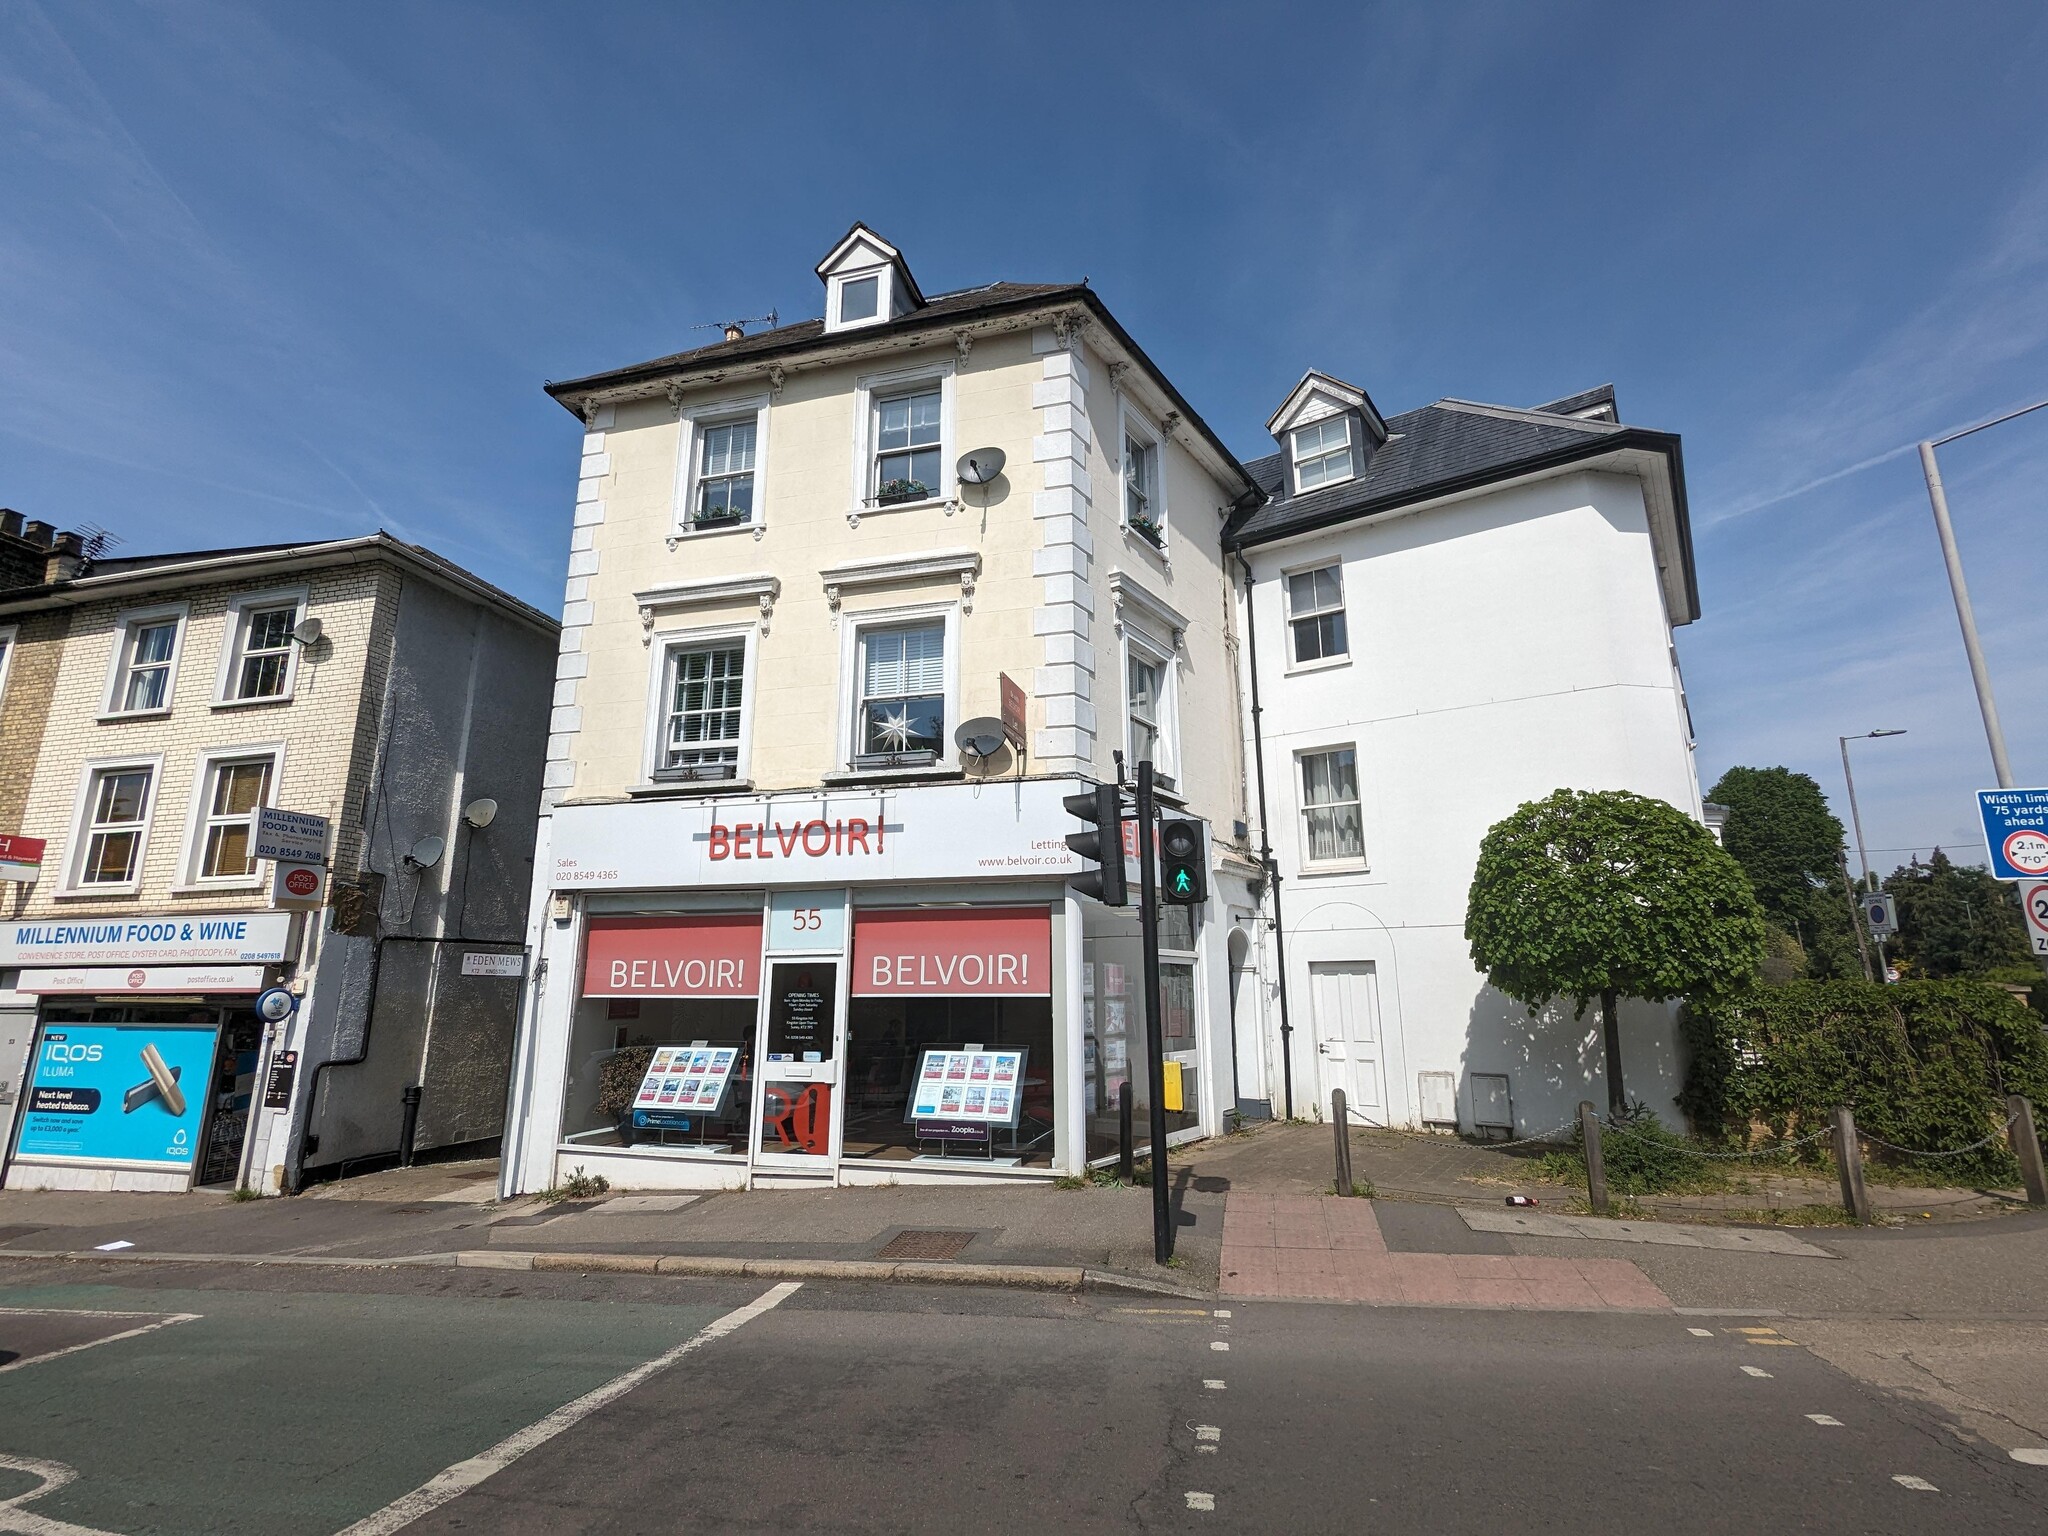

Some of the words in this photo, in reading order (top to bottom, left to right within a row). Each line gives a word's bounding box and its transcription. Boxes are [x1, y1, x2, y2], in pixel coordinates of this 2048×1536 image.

[1983, 795, 2021, 804] Width
[2025, 793, 2048, 803] limi
[1992, 806, 2010, 815] 75
[2013, 804, 2048, 816] yards
[264, 811, 324, 828] MILLENNIUM
[2004, 816, 2044, 826] ahead
[262, 821, 288, 831] FOOD
[290, 825, 297, 833] &
[300, 827, 324, 837] WINE
[708, 815, 884, 861] BELVOIR!
[1031, 839, 1069, 851] Letting
[2016, 841, 2046, 849] 2.1m
[259, 845, 277, 855] 020
[280, 848, 302, 857] 8549
[305, 851, 321, 860] 7618
[557, 858, 577, 867] Sales
[978, 854, 1072, 866] www.belvoir.co.uk
[294, 874, 312, 882] POST
[556, 872, 571, 880] 020
[573, 871, 595, 880] 8549
[597, 870, 618, 879] 4365
[288, 881, 315, 890] OFFICE
[2035, 899, 2048, 918] 2
[793, 908, 822, 930] 55
[16, 925, 123, 944] MILLENNIUM
[126, 924, 176, 942] FOOD
[180, 923, 194, 940] &
[200, 922, 247, 940] WINE
[18, 952, 62, 960] CONVENIENCE
[88, 951, 105, 959] POST
[132, 949, 157, 958] OYSTER
[224, 948, 238, 956] FAX
[472, 955, 495, 965] EDEN
[497, 957, 521, 967] MEWS
[610, 959, 744, 988] BELVOIR!
[872, 954, 1028, 986] BELVOIR!
[66, 976, 84, 984] Office
[187, 975, 234, 984] postoffice.co.uk
[46, 1045, 103, 1063] IQOS
[43, 1067, 74, 1076] ILUMA
[56, 1091, 73, 1099] level
[36, 1101, 61, 1109] heated
[61, 1102, 90, 1110] tobacco.
[166, 1147, 189, 1155] IQOS
